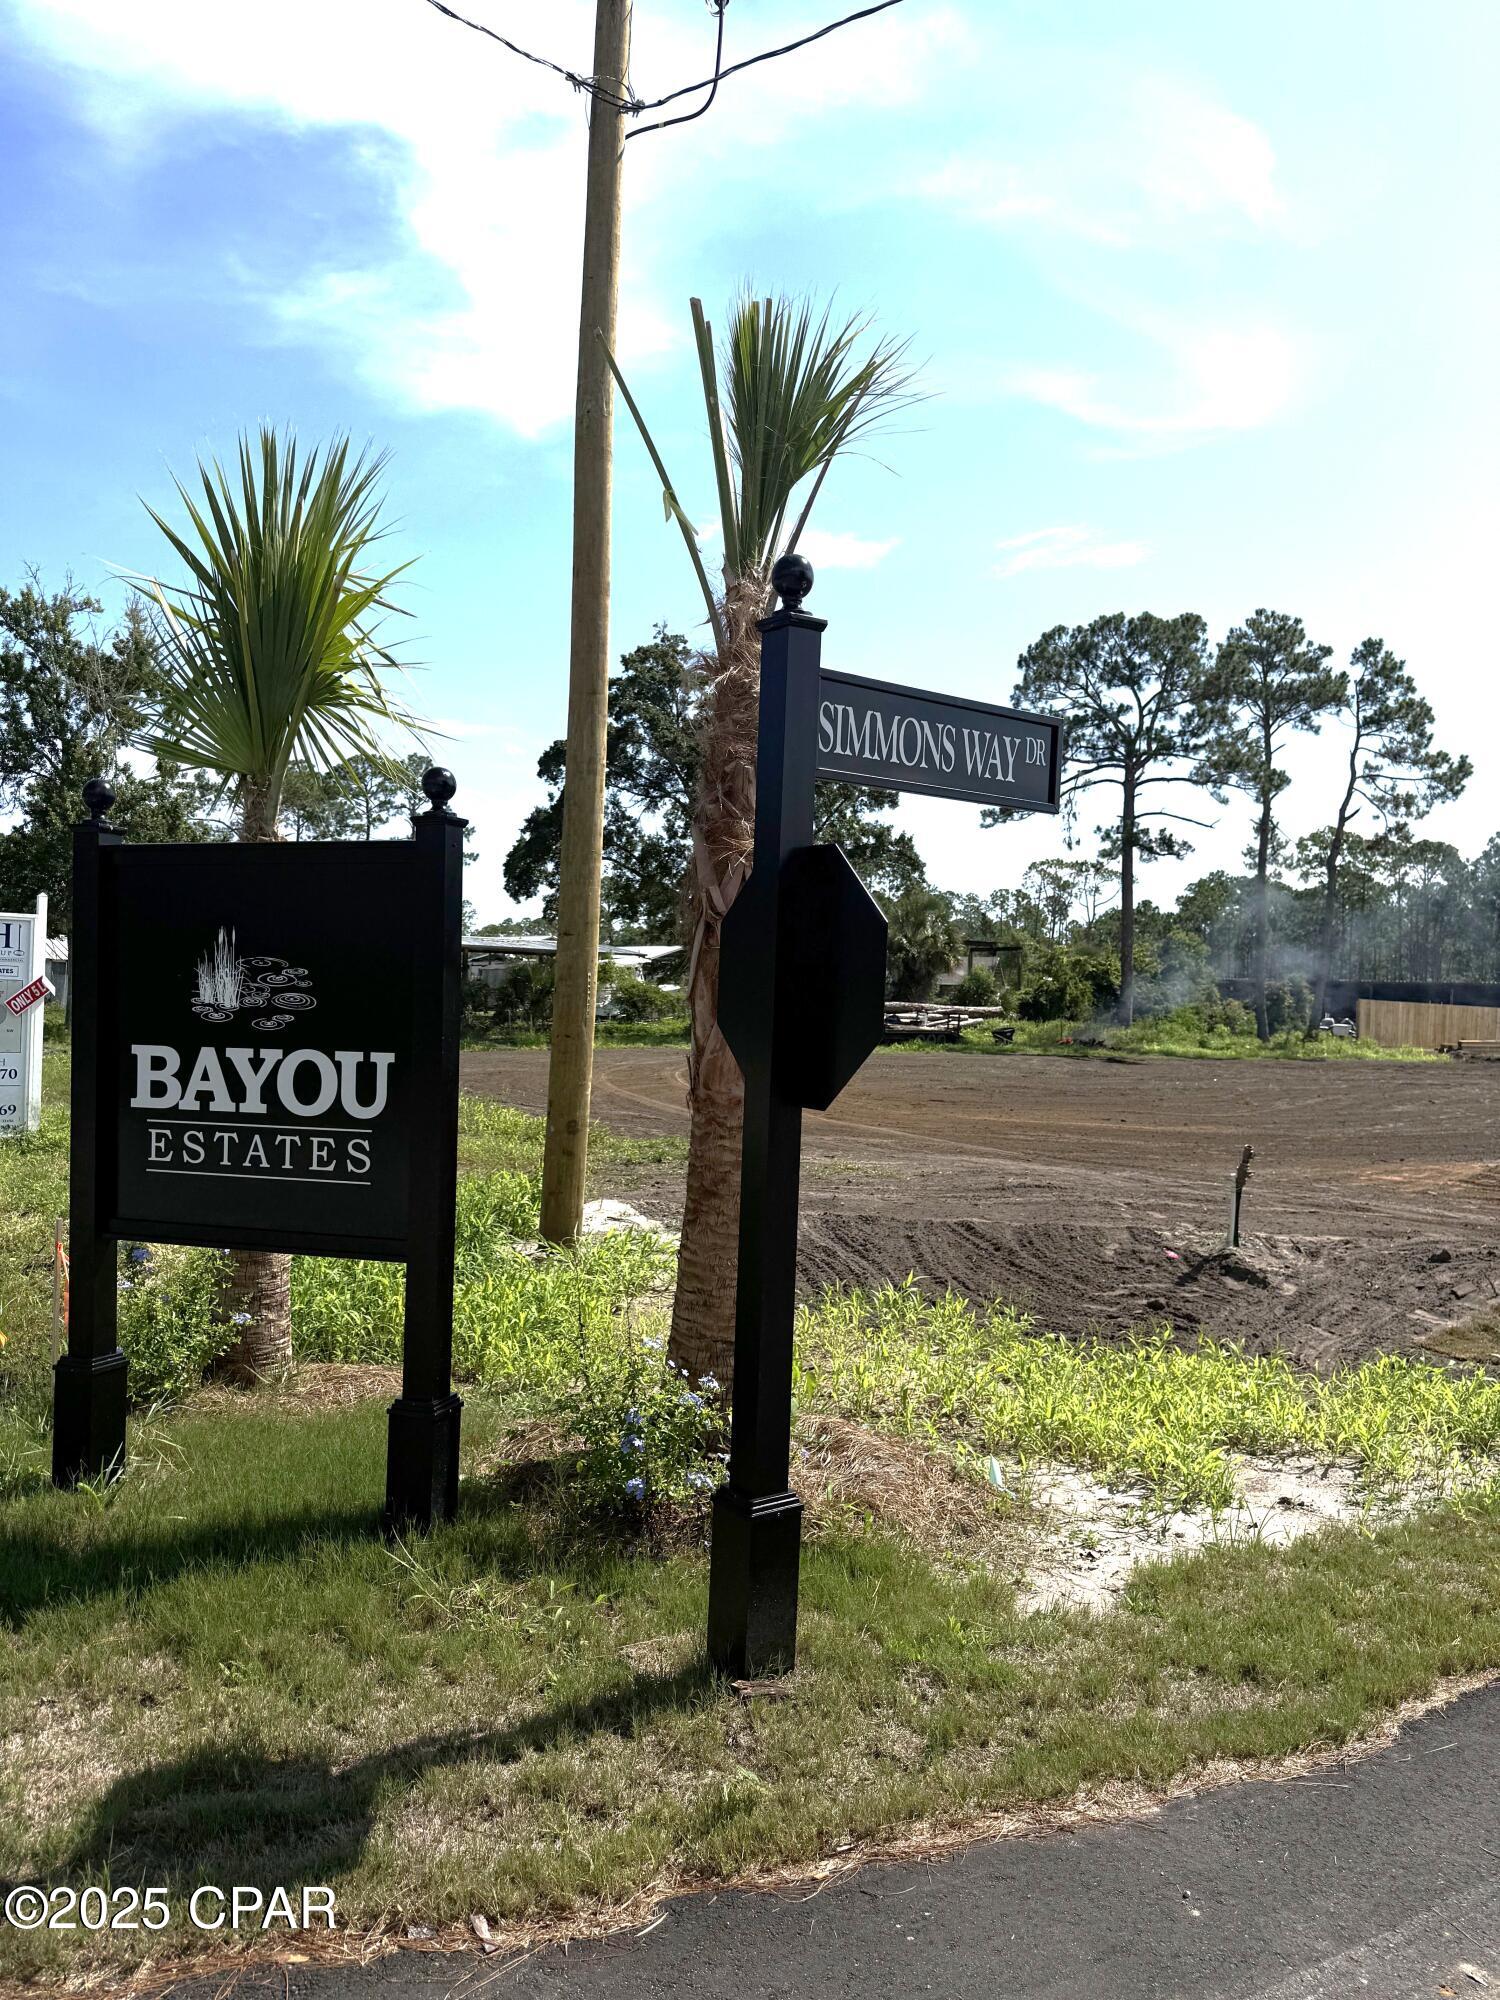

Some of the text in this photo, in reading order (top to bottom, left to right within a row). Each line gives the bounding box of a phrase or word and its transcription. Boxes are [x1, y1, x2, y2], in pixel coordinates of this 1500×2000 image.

[818, 700, 1047, 783] SIMMONS WAY DR
[11, 988, 34, 1012] ONLY
[32, 985, 41, 996] 5
[131, 1044, 395, 1119] BAYOU
[148, 1128, 371, 1174] ESTATES
